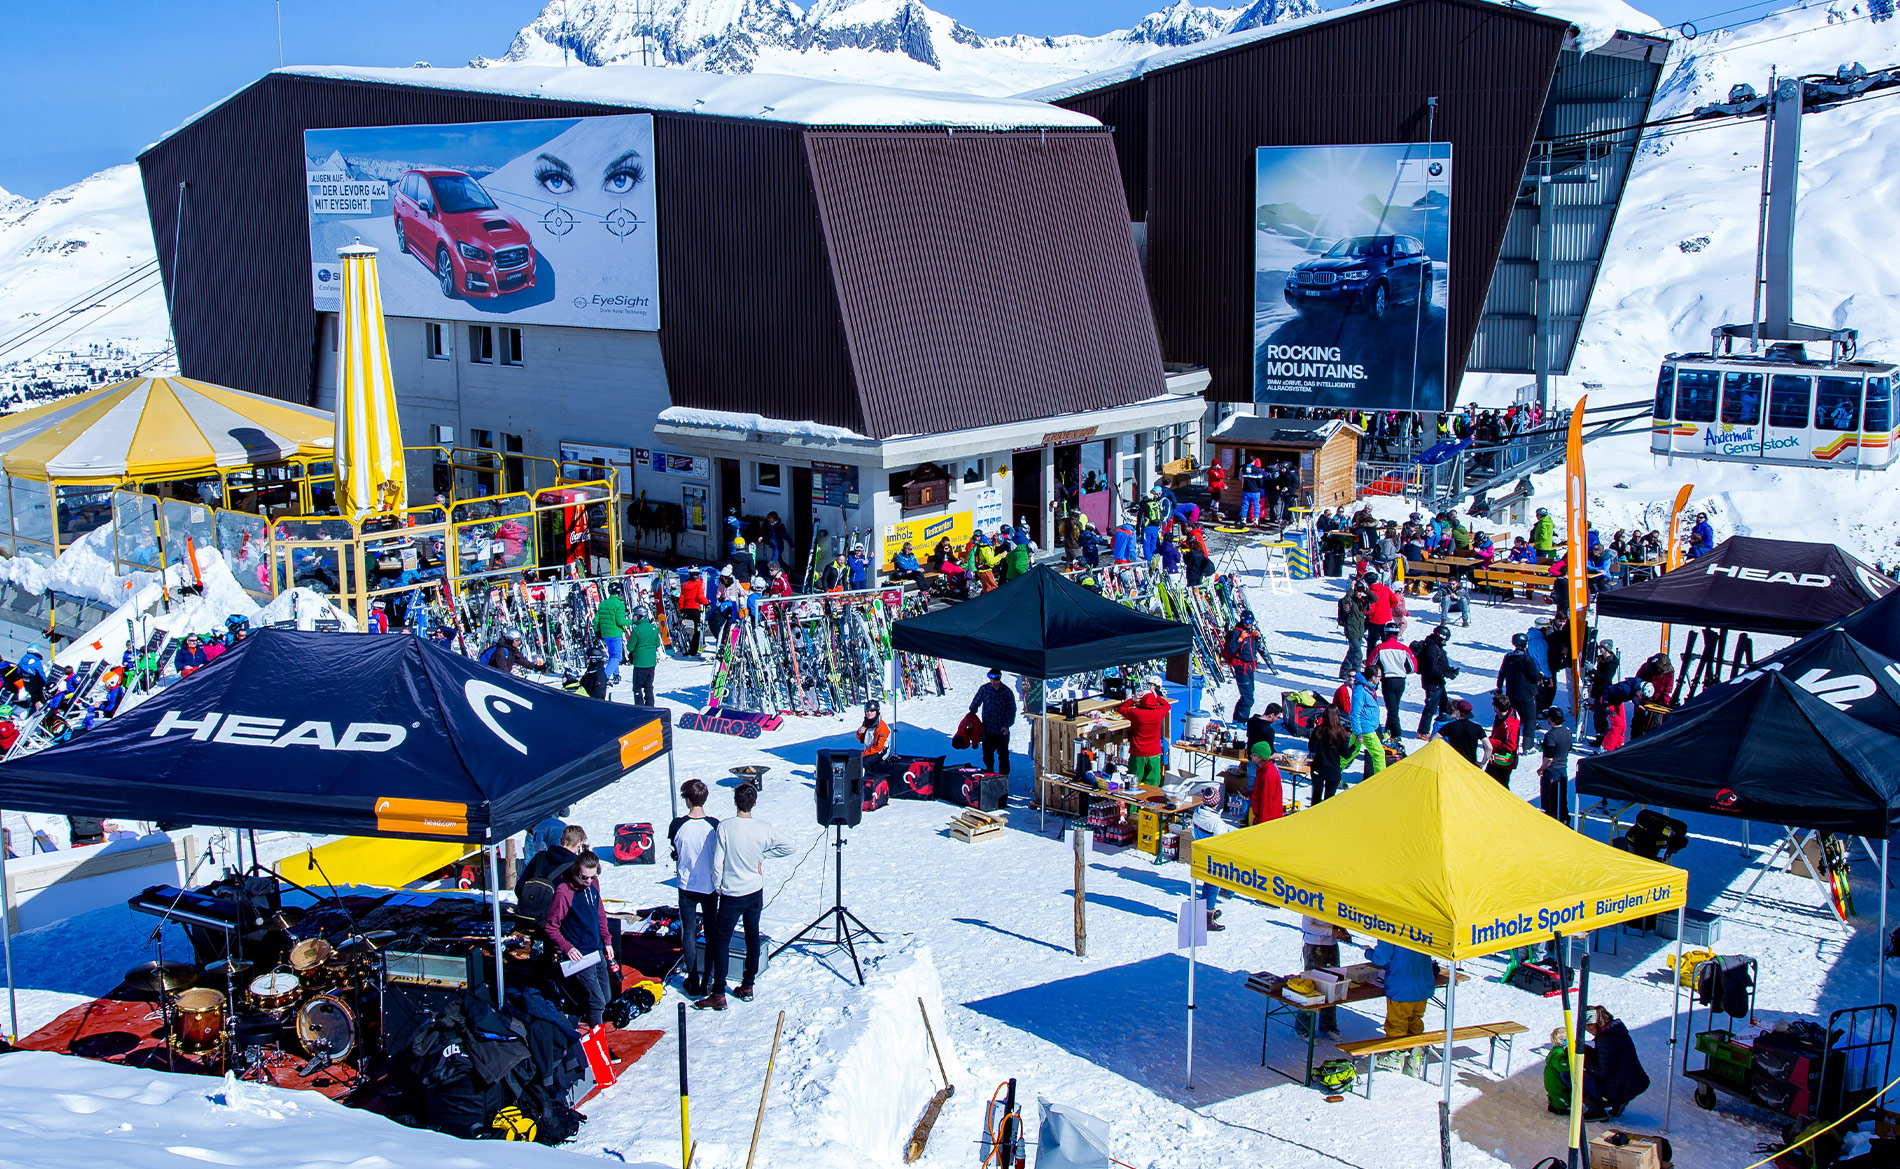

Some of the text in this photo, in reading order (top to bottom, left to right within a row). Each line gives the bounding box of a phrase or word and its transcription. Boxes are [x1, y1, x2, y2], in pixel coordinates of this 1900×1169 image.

[312, 174, 345, 183] AUGEN AUF.
[322, 185, 386, 197] DER LEVORG 4x4
[315, 199, 370, 210] MIT EYESIGHT.
[592, 294, 650, 308] EyeSight
[1267, 344, 1341, 361] ROCKING
[1267, 361, 1368, 379] MOUNTAINS.
[1316, 381, 1356, 389] INTELLIGENTE
[1704, 427, 1755, 446] Andermatt
[1723, 436, 1800, 455] Gemsstock
[886, 530, 912, 543] Imholz
[926, 520, 953, 537] Testcenter
[1706, 563, 1832, 588] HEAD
[150, 711, 407, 752] HEAD
[694, 714, 745, 736] NITRO
[424, 818, 457, 827] head.com
[1207, 855, 1433, 946] Imholz Sport Bürglen / Uri
[1471, 885, 1671, 945] Imholz Sport Bürglen / Uri
